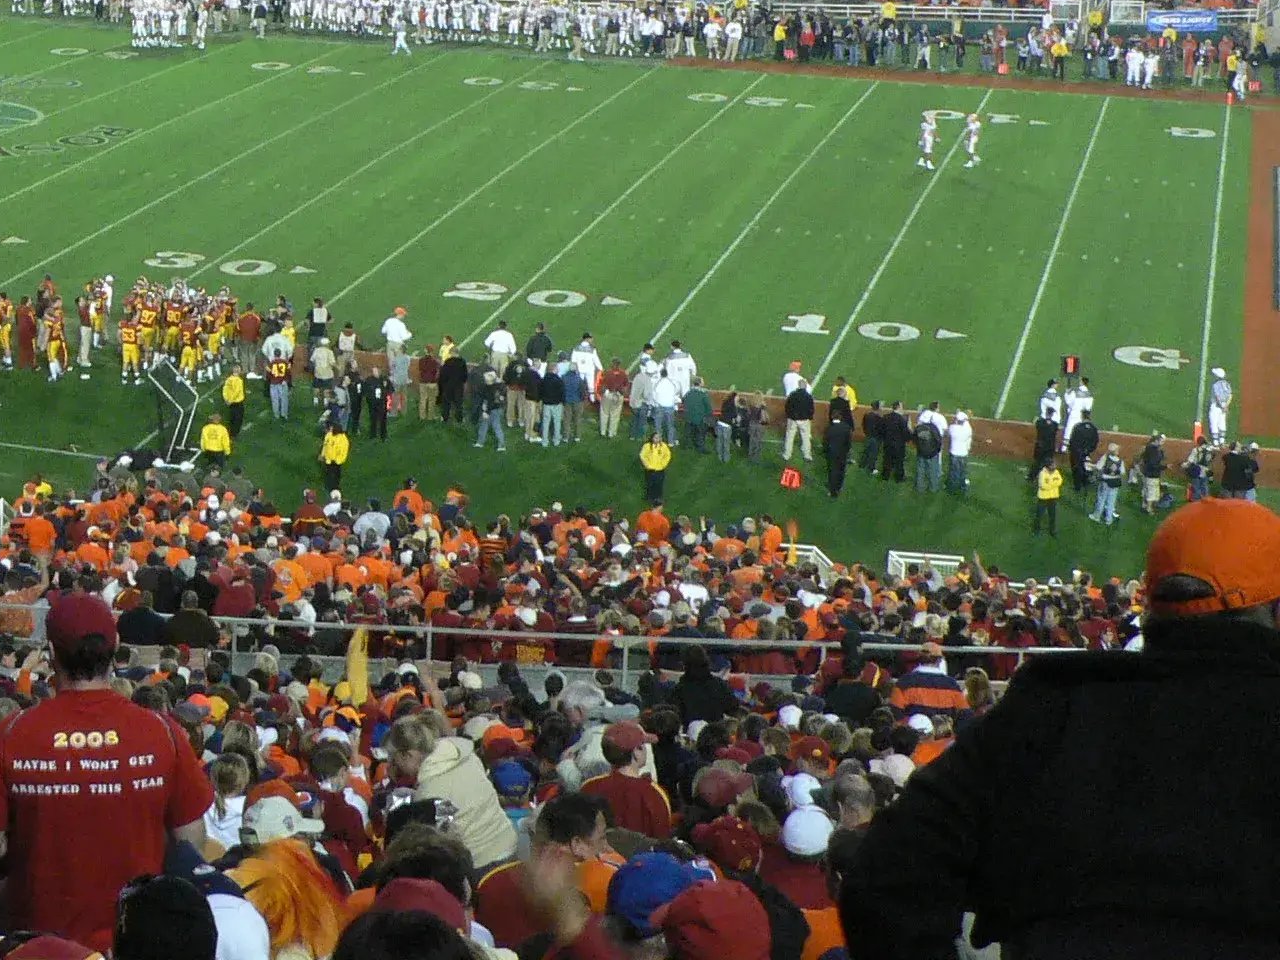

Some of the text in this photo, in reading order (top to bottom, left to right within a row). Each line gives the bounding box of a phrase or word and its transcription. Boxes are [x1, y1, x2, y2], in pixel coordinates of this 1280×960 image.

[271, 363, 286, 377] 43
[53, 730, 120, 749] 2008
[13, 759, 58, 771] MAYBE
[66, 760, 70, 771] I
[129, 754, 155, 768] GET
[12, 776, 164, 795] ARRESTED THIS YEAR
